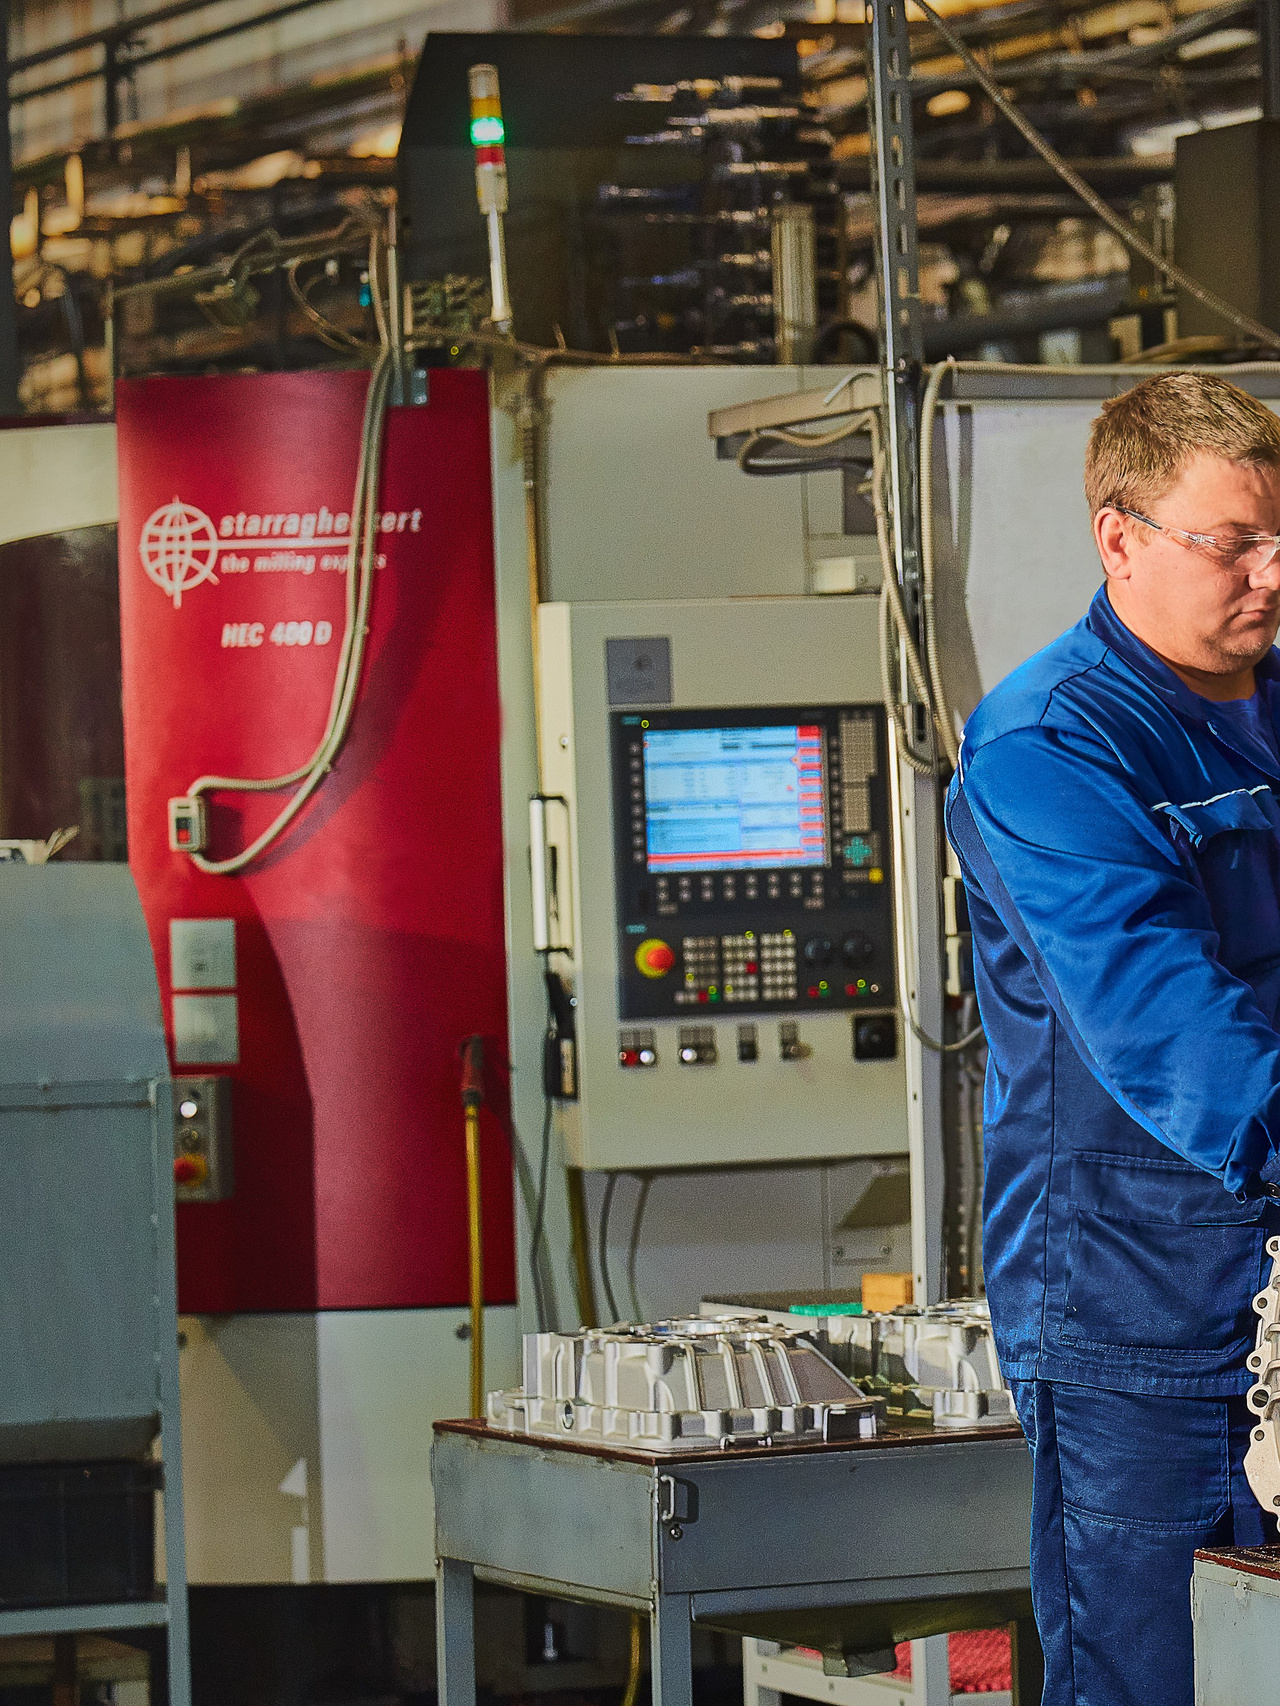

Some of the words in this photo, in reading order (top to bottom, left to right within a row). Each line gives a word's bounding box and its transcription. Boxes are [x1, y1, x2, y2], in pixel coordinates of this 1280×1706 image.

[220, 553, 250, 573] the
[254, 551, 316, 575] milling
[221, 622, 265, 648] HEC
